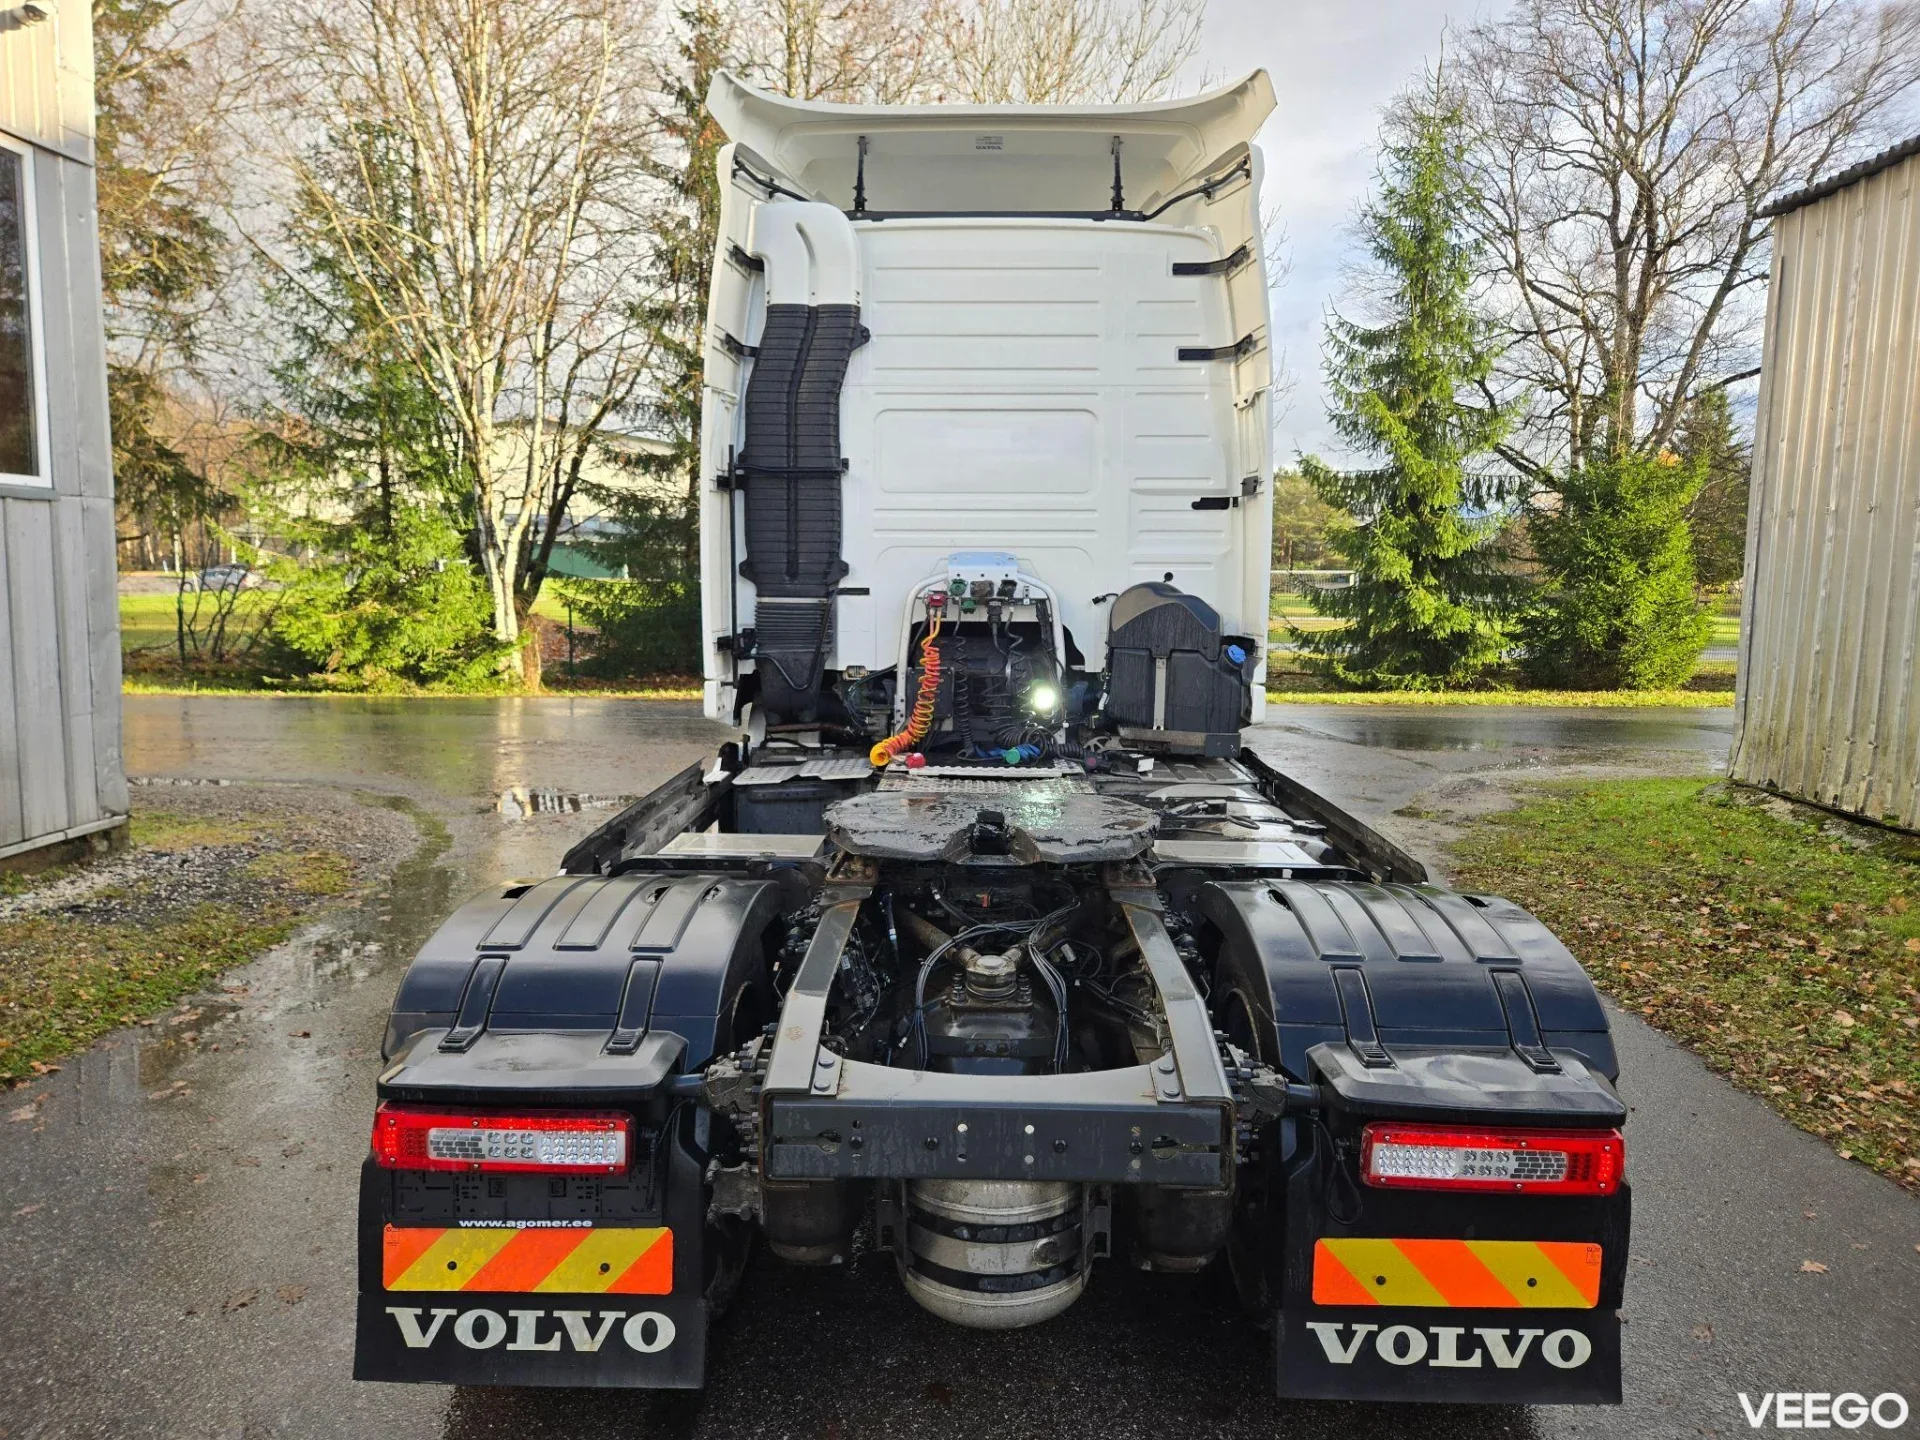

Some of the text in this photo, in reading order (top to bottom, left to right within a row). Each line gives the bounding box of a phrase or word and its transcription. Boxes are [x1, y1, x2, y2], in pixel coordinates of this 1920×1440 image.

[459, 1219, 593, 1229] www.agomer.ee
[385, 1307, 676, 1353] VOLVO
[1306, 1322, 1592, 1369] VOLVO
